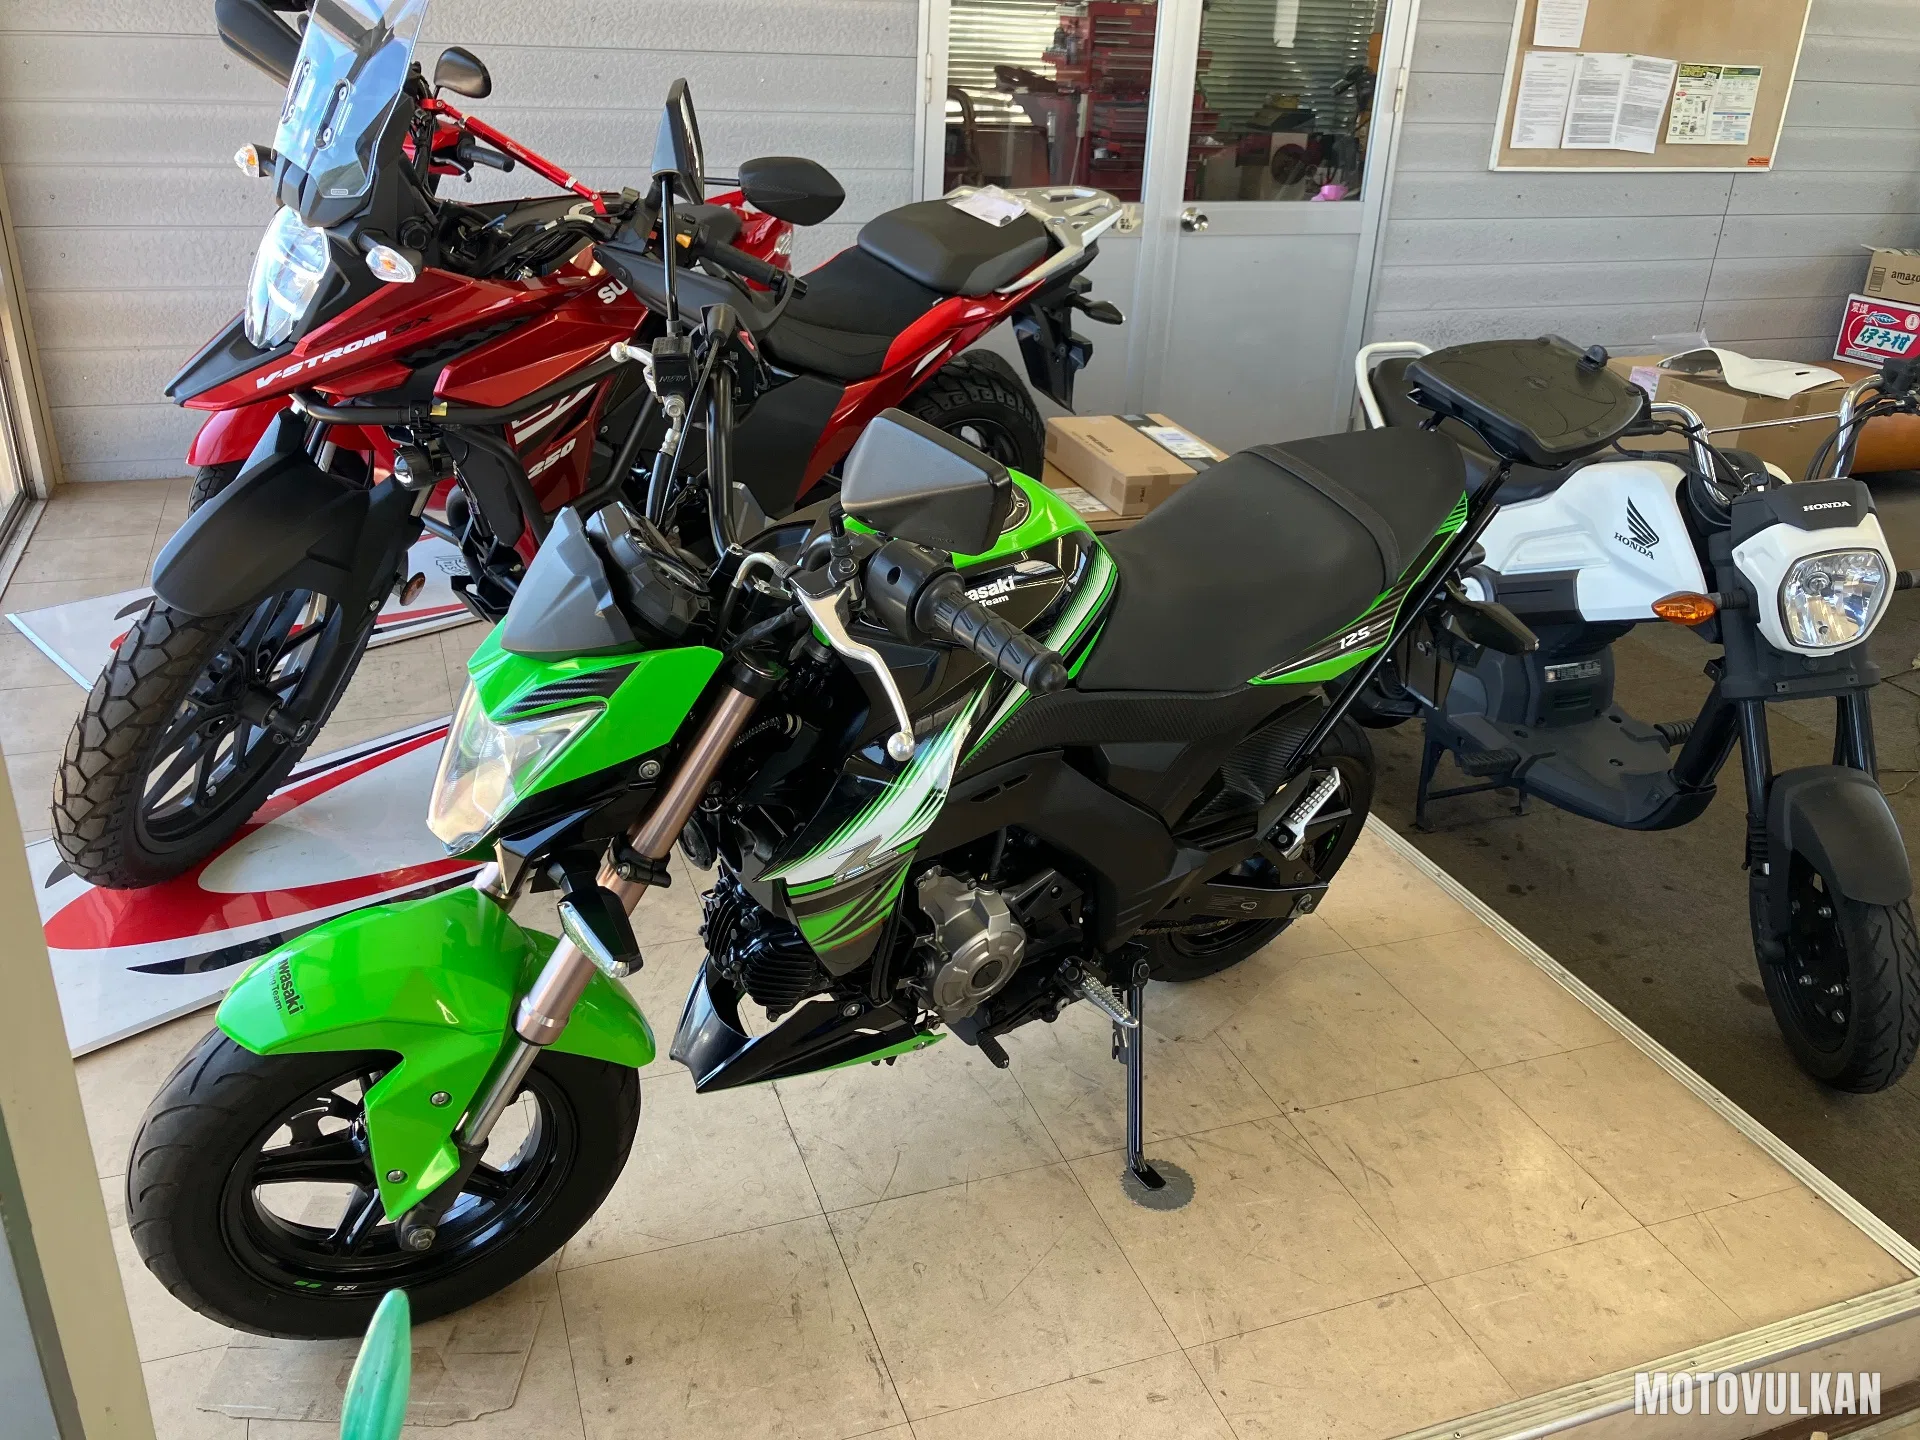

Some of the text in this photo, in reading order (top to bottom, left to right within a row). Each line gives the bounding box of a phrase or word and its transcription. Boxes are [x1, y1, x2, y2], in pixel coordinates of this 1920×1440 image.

[1860, 327, 1911, 352] 伊予柑
[256, 330, 387, 389] V-STROM
[527, 438, 577, 480] 250
[1803, 500, 1851, 512] HONDA
[1613, 531, 1655, 561] HONDA
[964, 575, 1016, 601] asaki
[978, 594, 1010, 608] Team
[1340, 625, 1371, 650] 125
[271, 984, 283, 1011] Team
